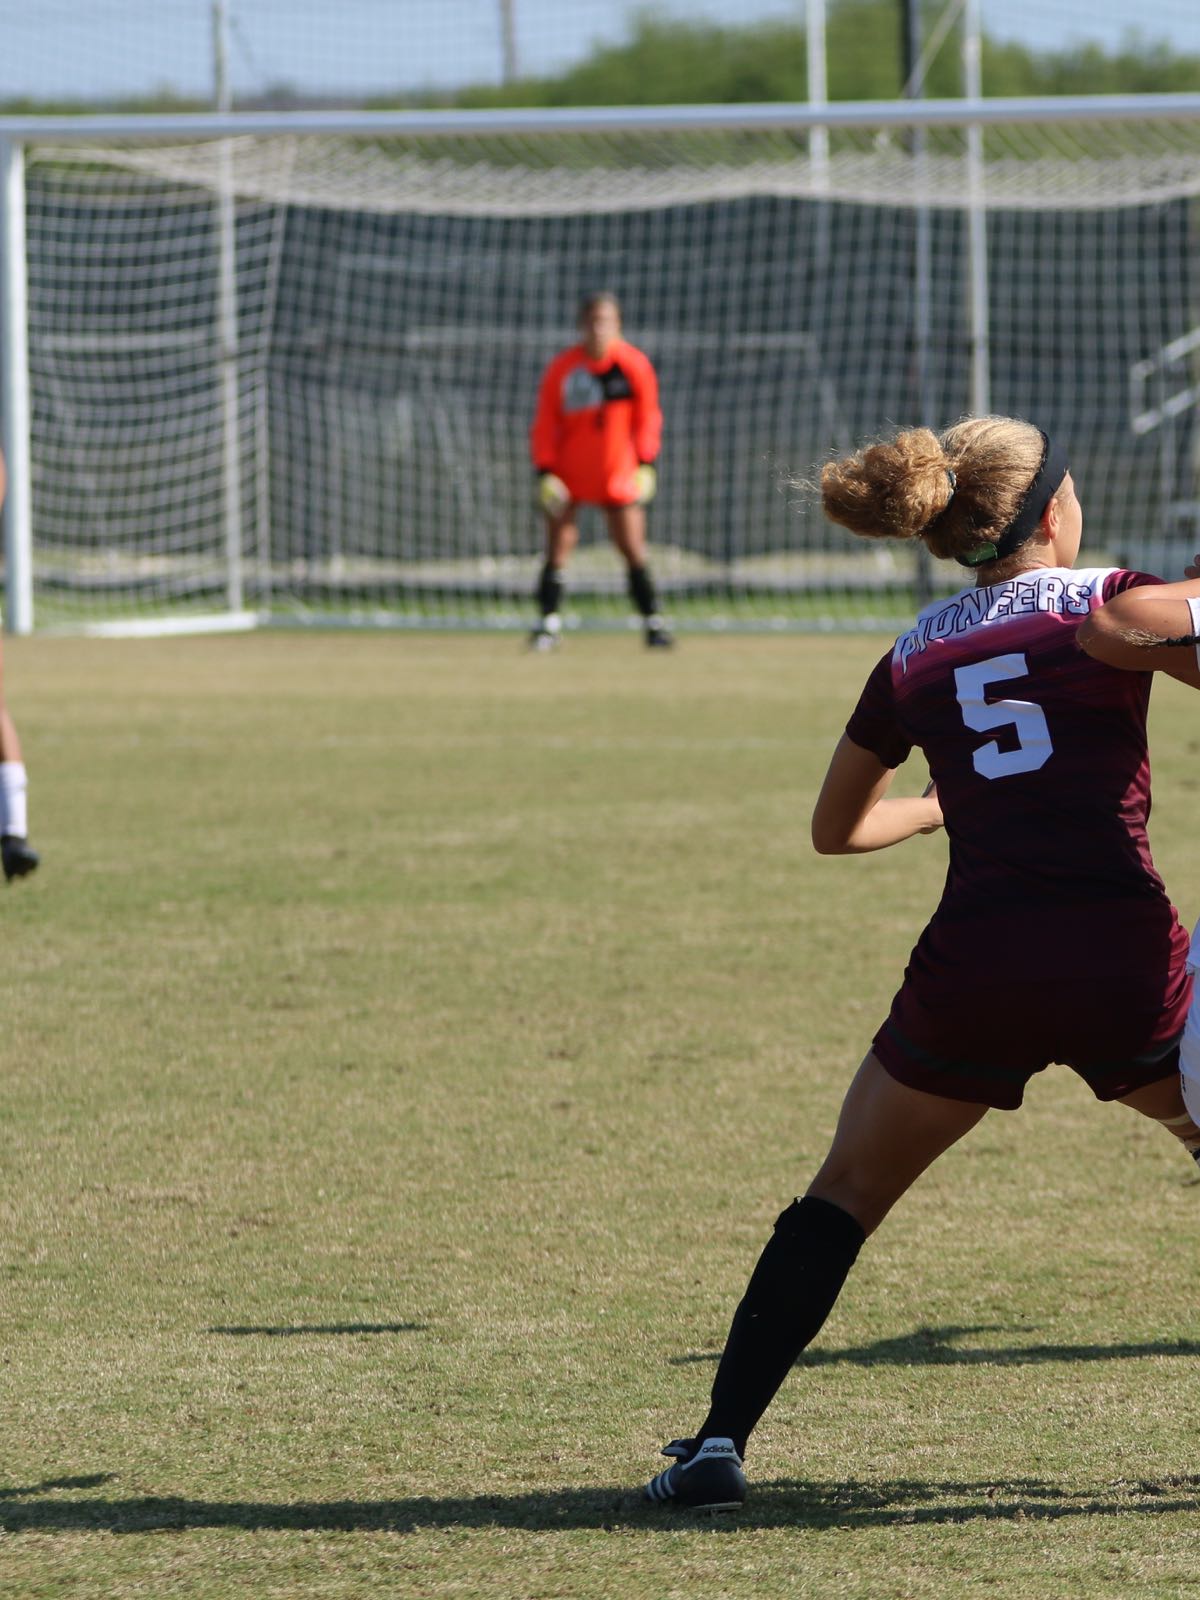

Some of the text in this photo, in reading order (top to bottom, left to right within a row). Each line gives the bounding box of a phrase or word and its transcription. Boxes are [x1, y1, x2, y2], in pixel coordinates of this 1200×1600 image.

[897, 577, 1092, 675] PIONEERS
[953, 652, 1053, 780] 5
[702, 1445, 734, 1454] adidas
